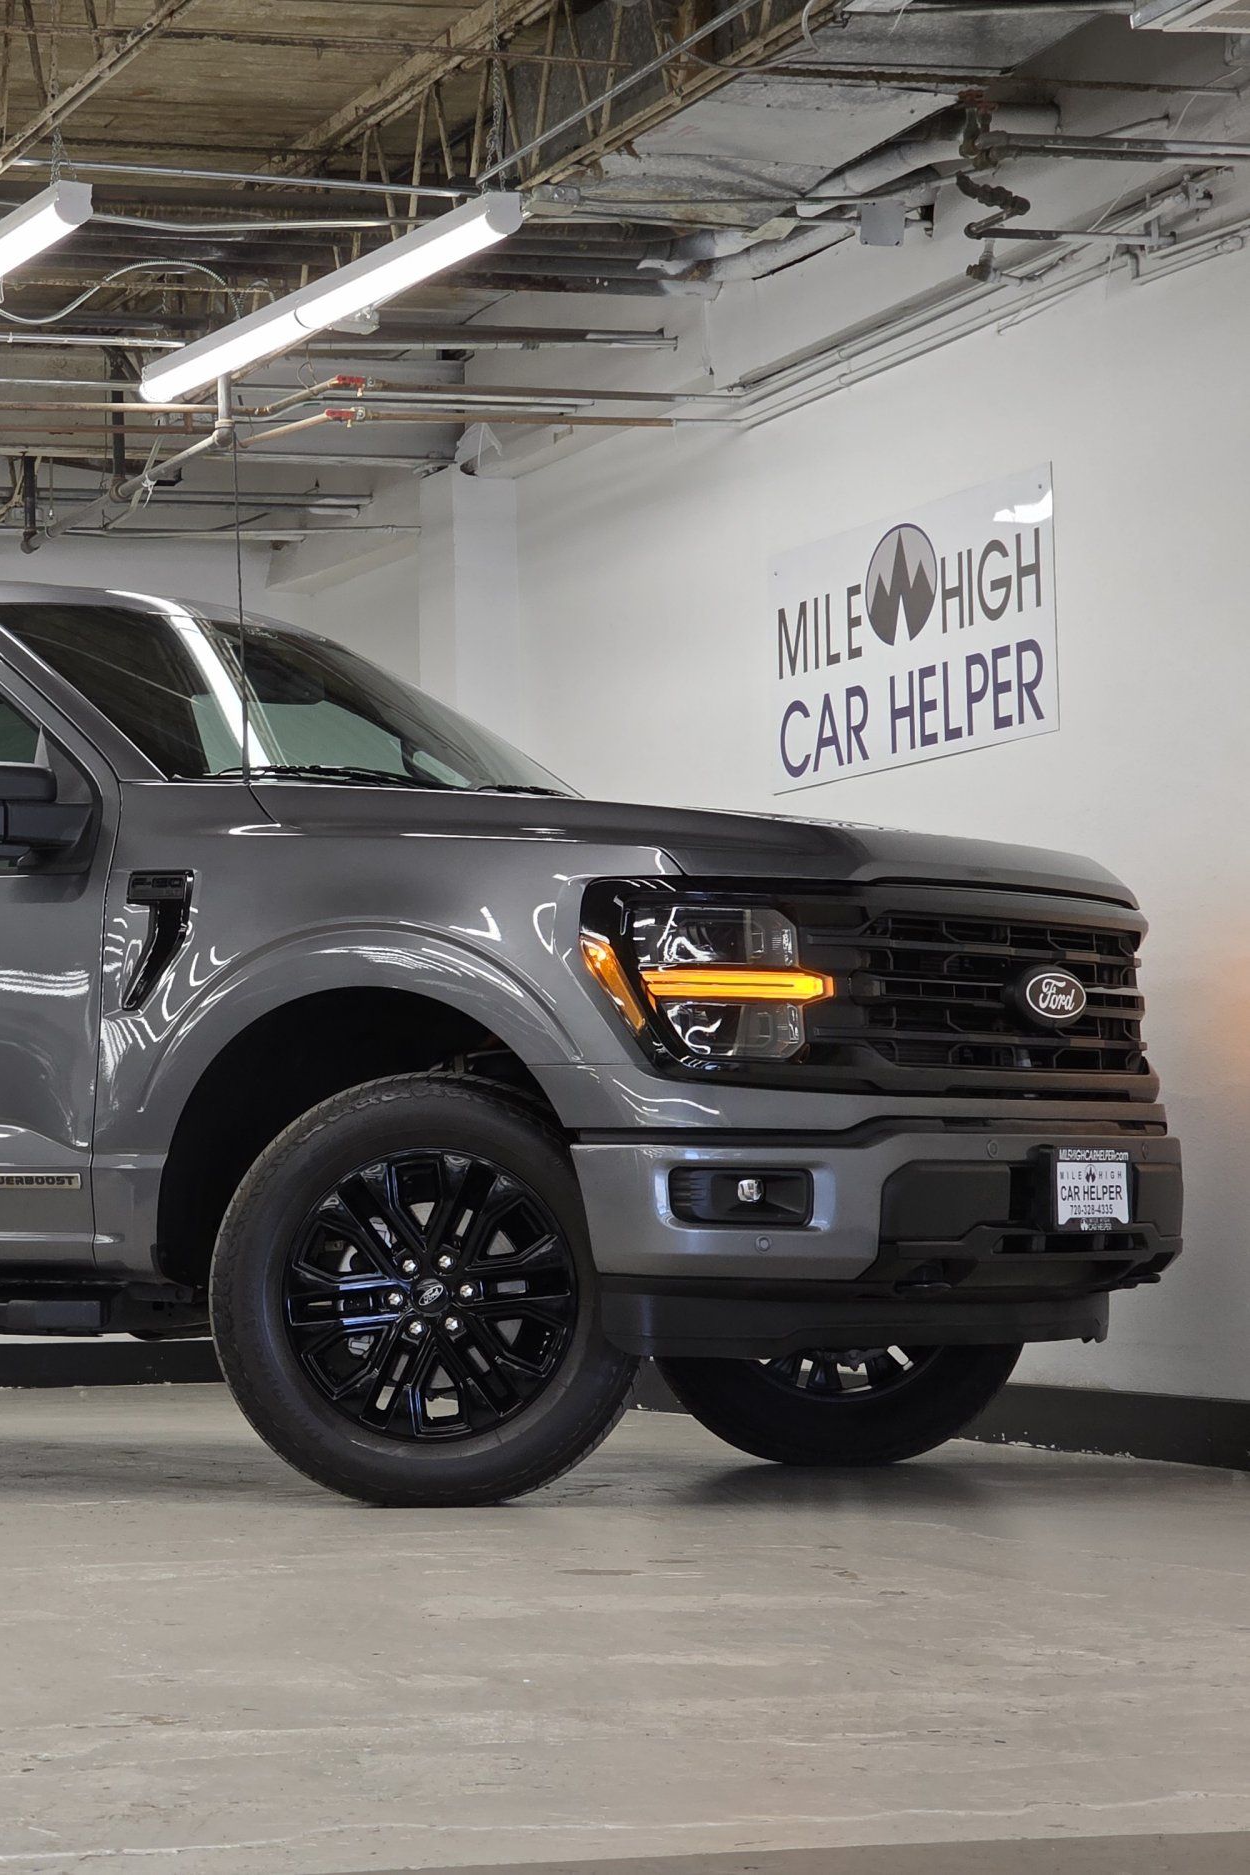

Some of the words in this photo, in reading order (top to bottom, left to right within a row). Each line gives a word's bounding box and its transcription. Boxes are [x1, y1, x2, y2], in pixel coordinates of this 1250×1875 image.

[778, 583, 863, 680] MILE
[940, 527, 1042, 634] HIGH
[780, 685, 870, 778] CAR
[889, 638, 1045, 754] HELPER
[1038, 978, 1076, 1011] Ford
[1060, 1170, 1082, 1180] MILE
[1098, 1170, 1122, 1180] HIGH
[1060, 1185, 1081, 1201] CAR
[1083, 1184, 1123, 1201] HELPER
